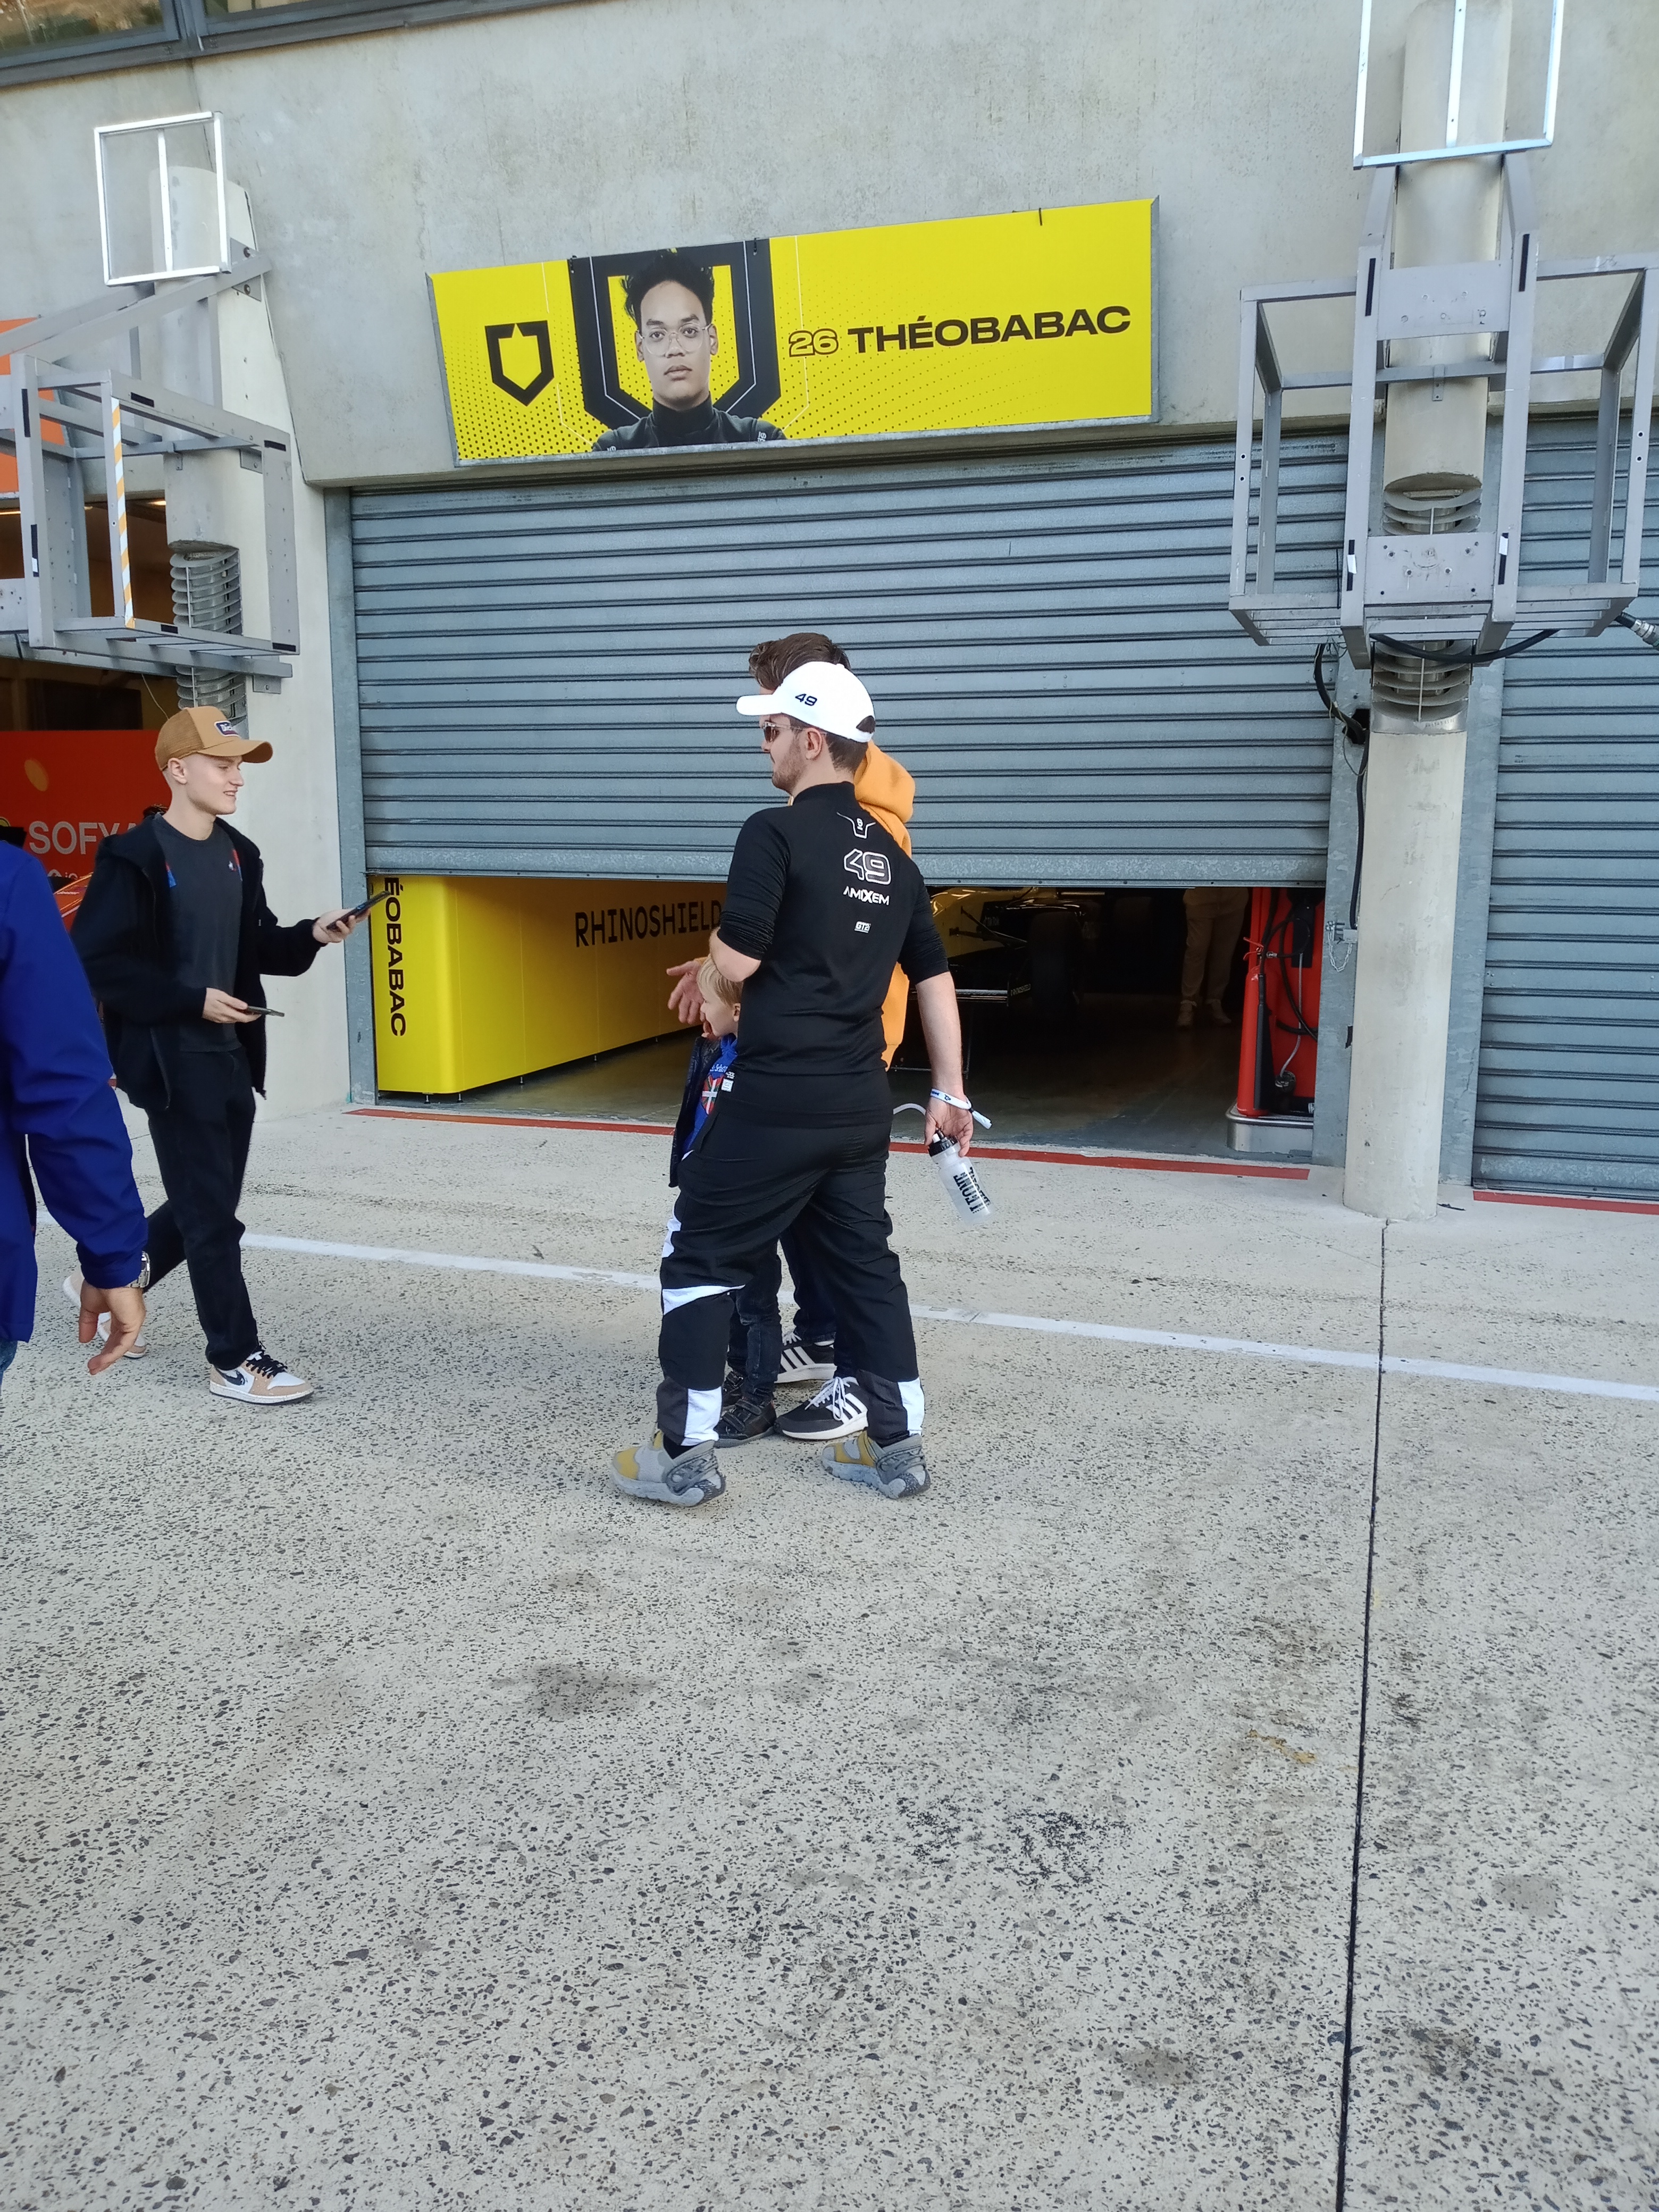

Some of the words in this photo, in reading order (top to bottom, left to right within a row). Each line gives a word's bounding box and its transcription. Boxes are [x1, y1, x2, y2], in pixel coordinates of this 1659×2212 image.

[789, 328, 839, 357] 26
[848, 305, 1132, 353] THÉOBABAC
[795, 693, 817, 706] 49
[844, 849, 891, 885] 49
[843, 886, 890, 906] AMIXEM
[575, 900, 722, 947] RHINOSHIELD
[953, 1167, 991, 1212] LEONE
